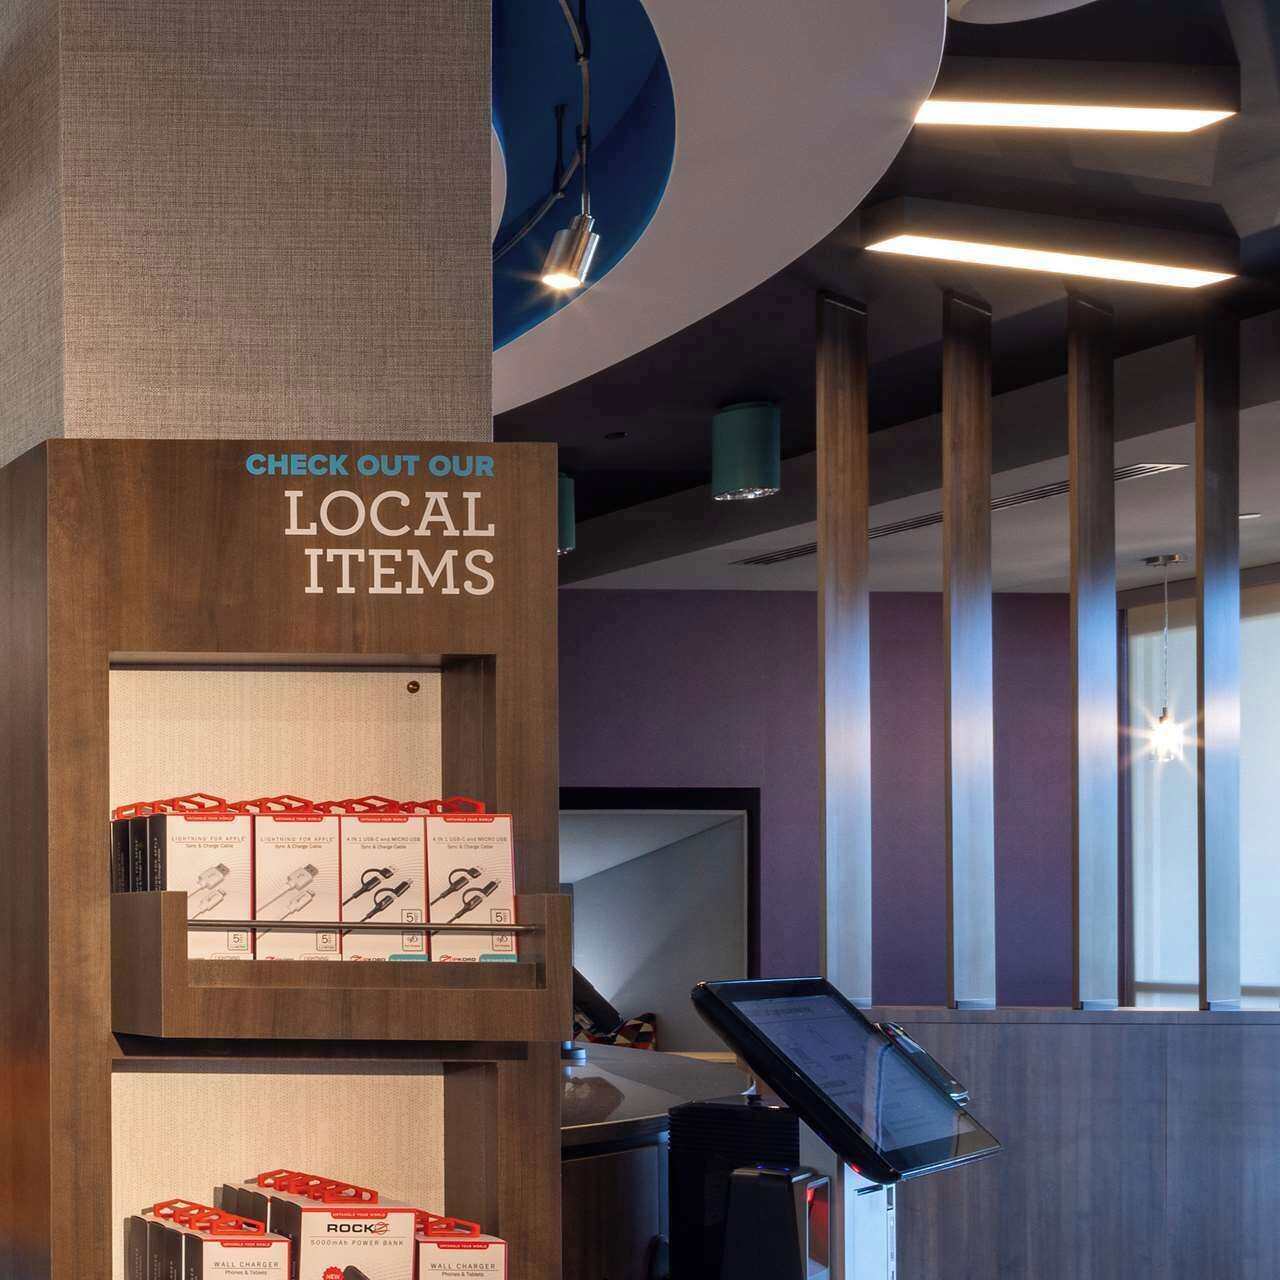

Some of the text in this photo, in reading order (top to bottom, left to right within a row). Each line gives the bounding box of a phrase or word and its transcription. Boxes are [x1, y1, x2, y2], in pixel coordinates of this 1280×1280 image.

[246, 454, 495, 478] CHECK OUT OUR
[284, 490, 496, 537] LOCAL
[304, 548, 495, 596] ITEMS
[352, 1239, 404, 1247] POWER BANK
